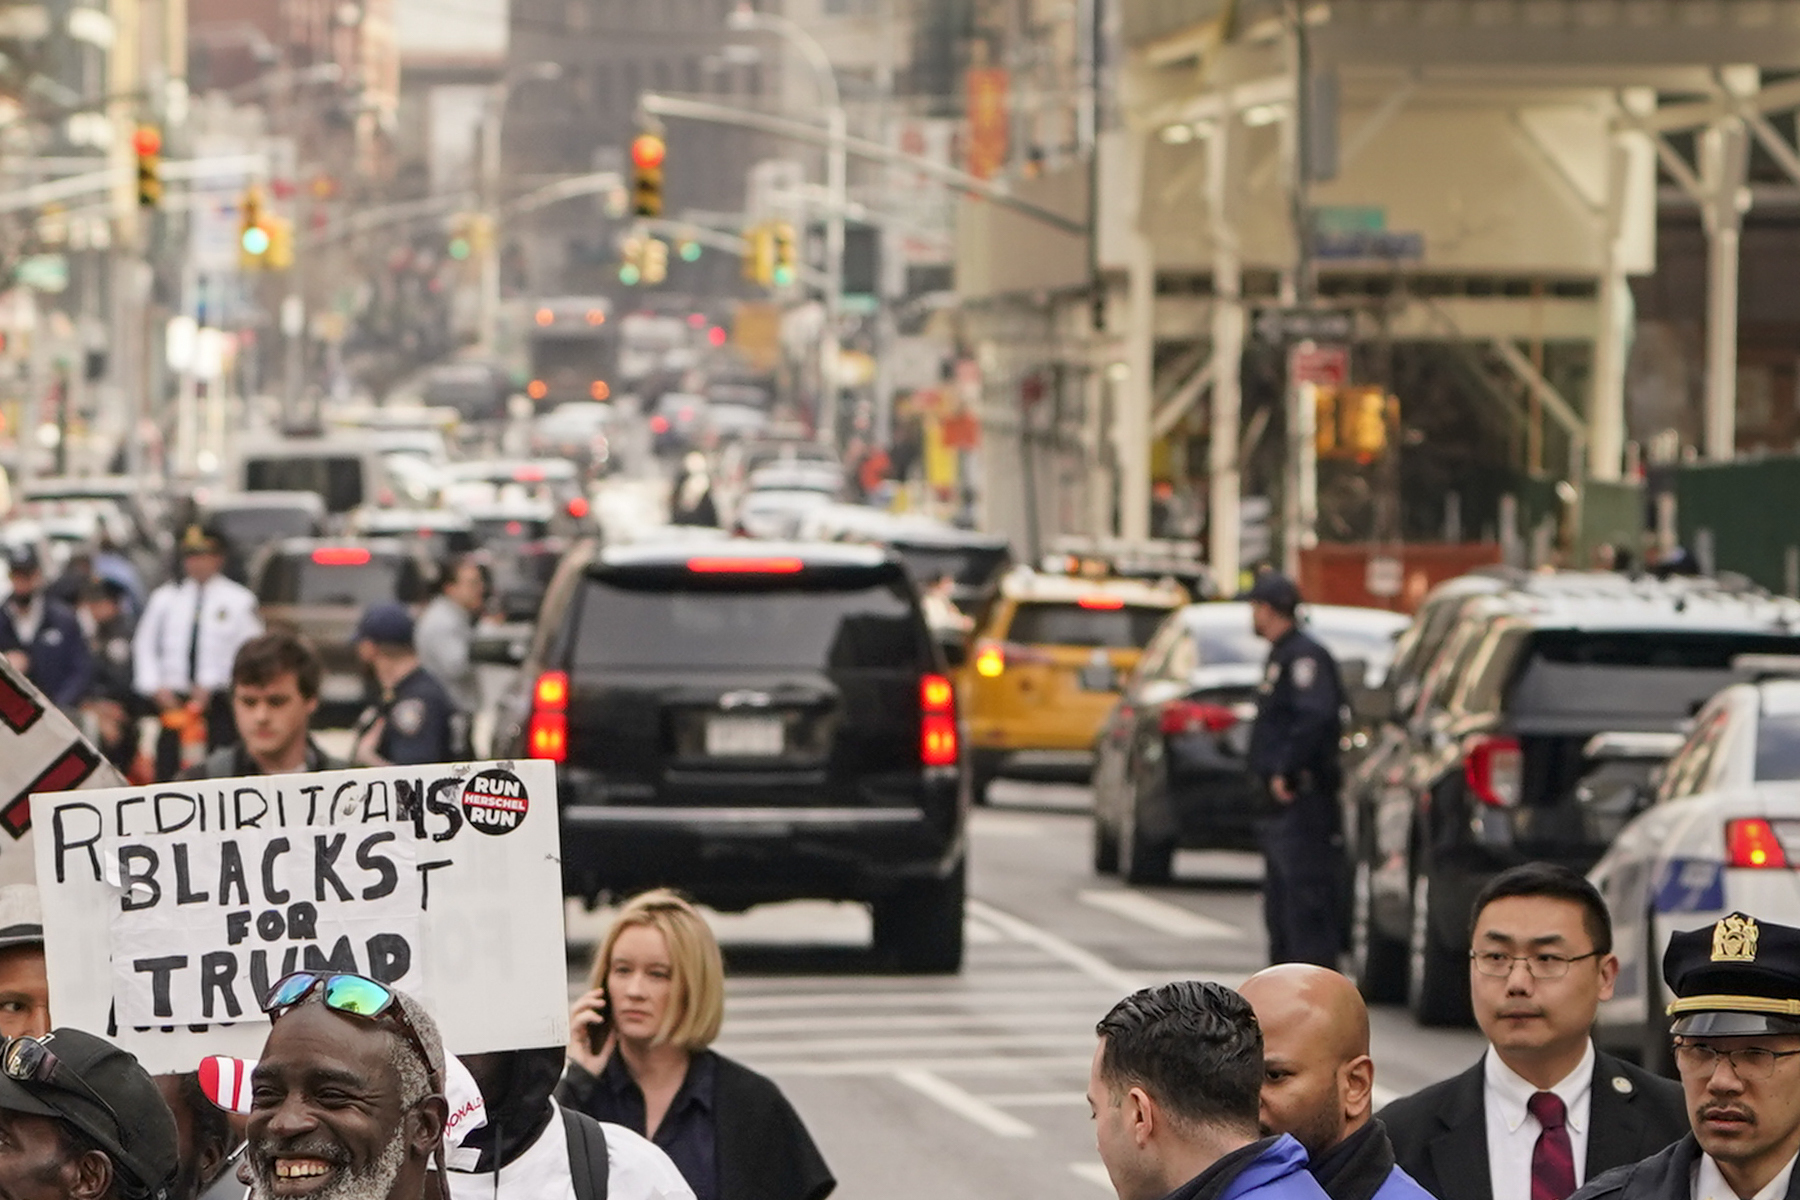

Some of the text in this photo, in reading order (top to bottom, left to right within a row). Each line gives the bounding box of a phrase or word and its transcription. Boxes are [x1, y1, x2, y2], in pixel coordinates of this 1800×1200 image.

[474, 777, 520, 798] RUN
[464, 794, 526, 811] HERSCHEL
[470, 807, 517, 827] RUN
[118, 832, 398, 912] BLACKS
[226, 901, 318, 945] FOR
